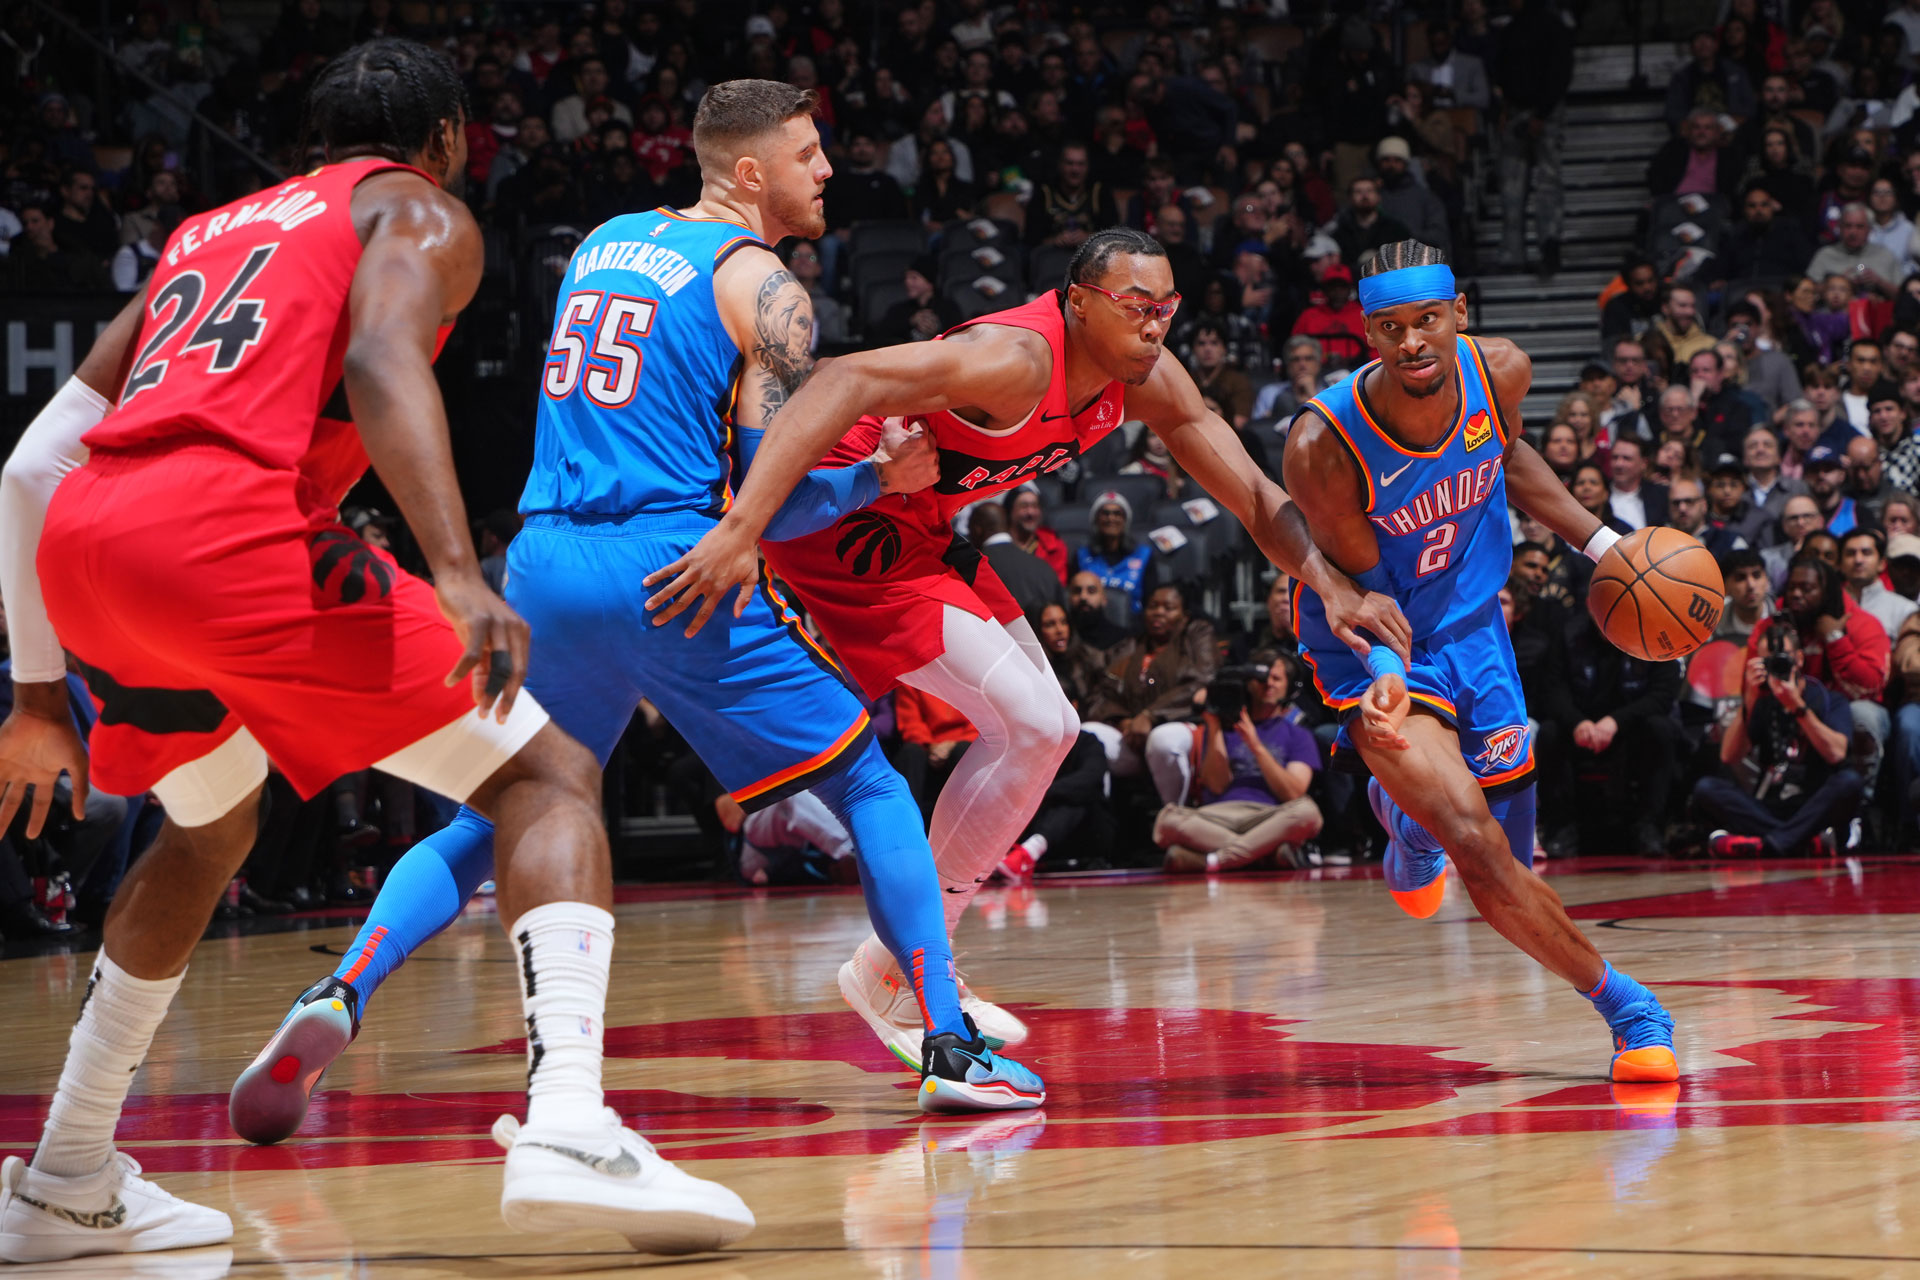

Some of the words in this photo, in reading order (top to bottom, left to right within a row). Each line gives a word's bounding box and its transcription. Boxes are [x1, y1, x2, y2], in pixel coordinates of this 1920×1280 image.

[574, 241, 698, 297] HARTENSTEIN
[8, 321, 110, 395] H
[118, 242, 280, 411] 24
[543, 290, 659, 410] 55
[1368, 454, 1503, 536] THUNDER
[1417, 521, 1459, 578] 2
[1490, 732, 1516, 762] OKC
